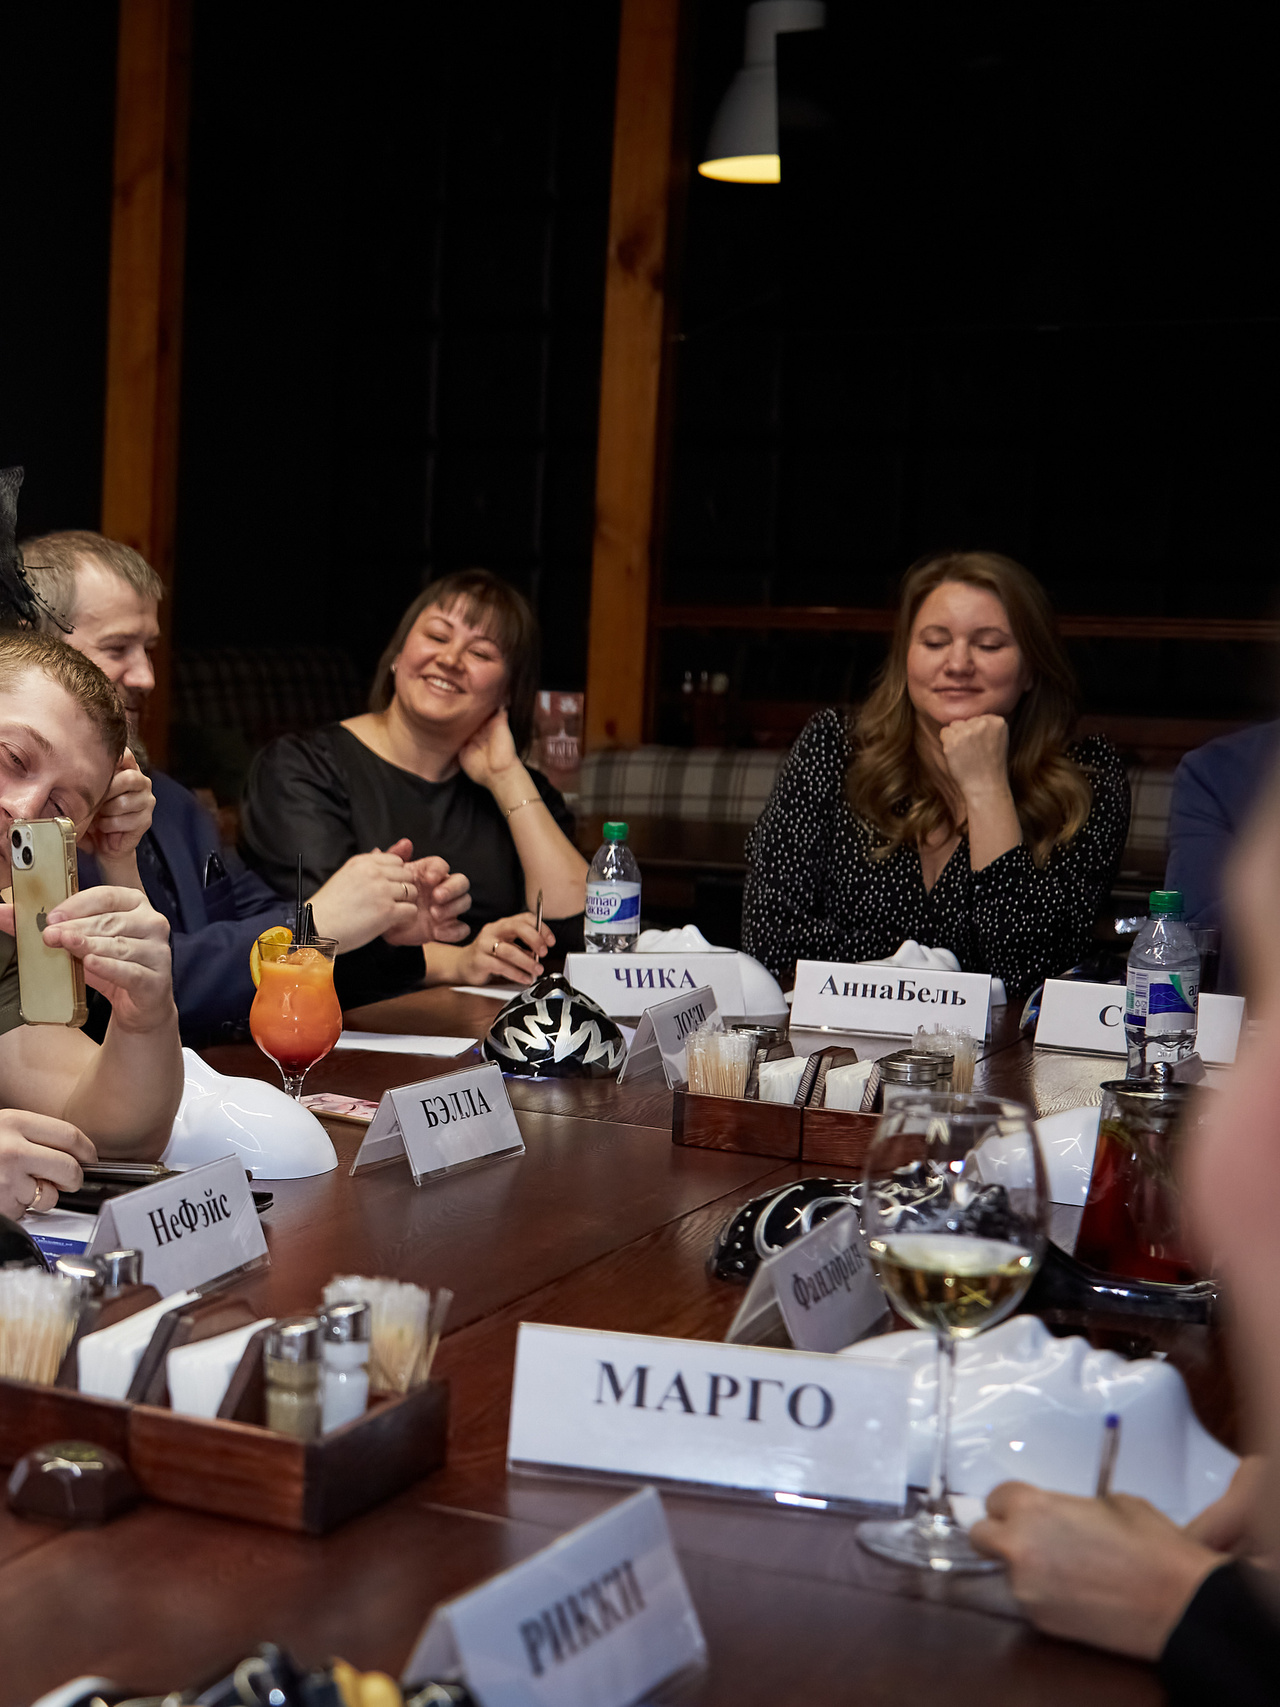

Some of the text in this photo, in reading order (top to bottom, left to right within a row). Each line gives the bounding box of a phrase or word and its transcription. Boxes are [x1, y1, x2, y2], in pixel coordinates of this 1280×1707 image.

[614, 967, 698, 989] ЧИКА
[818, 974, 967, 1006] АннаБель
[421, 1086, 493, 1130] БЭЛЛА
[147, 1189, 232, 1247] НеФэйс
[594, 1361, 837, 1430] МАРГО
[519, 1559, 647, 1678] РИККИ
